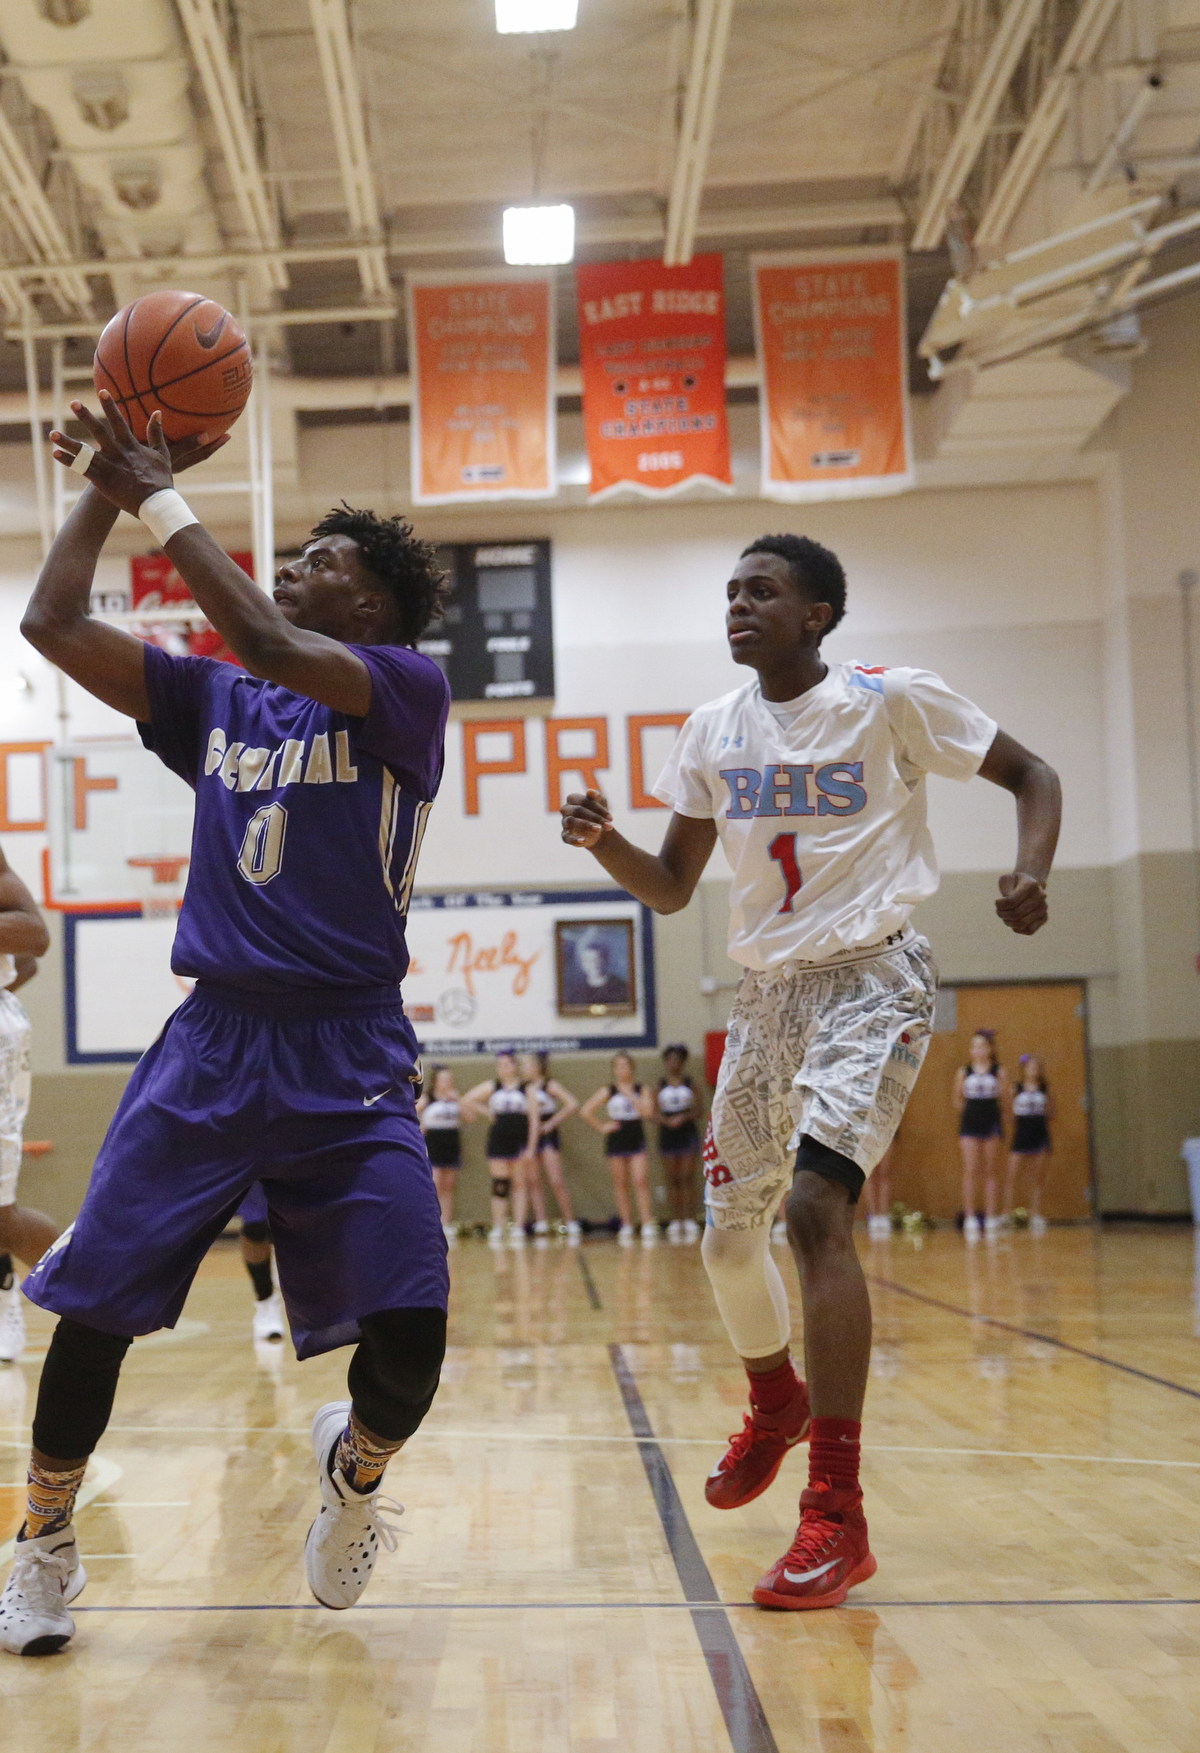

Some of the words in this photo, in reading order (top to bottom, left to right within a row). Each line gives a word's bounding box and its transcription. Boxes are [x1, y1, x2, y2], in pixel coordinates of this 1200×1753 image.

[719, 762, 867, 819] BHS
[237, 801, 288, 886] 0
[767, 832, 803, 915] 1
